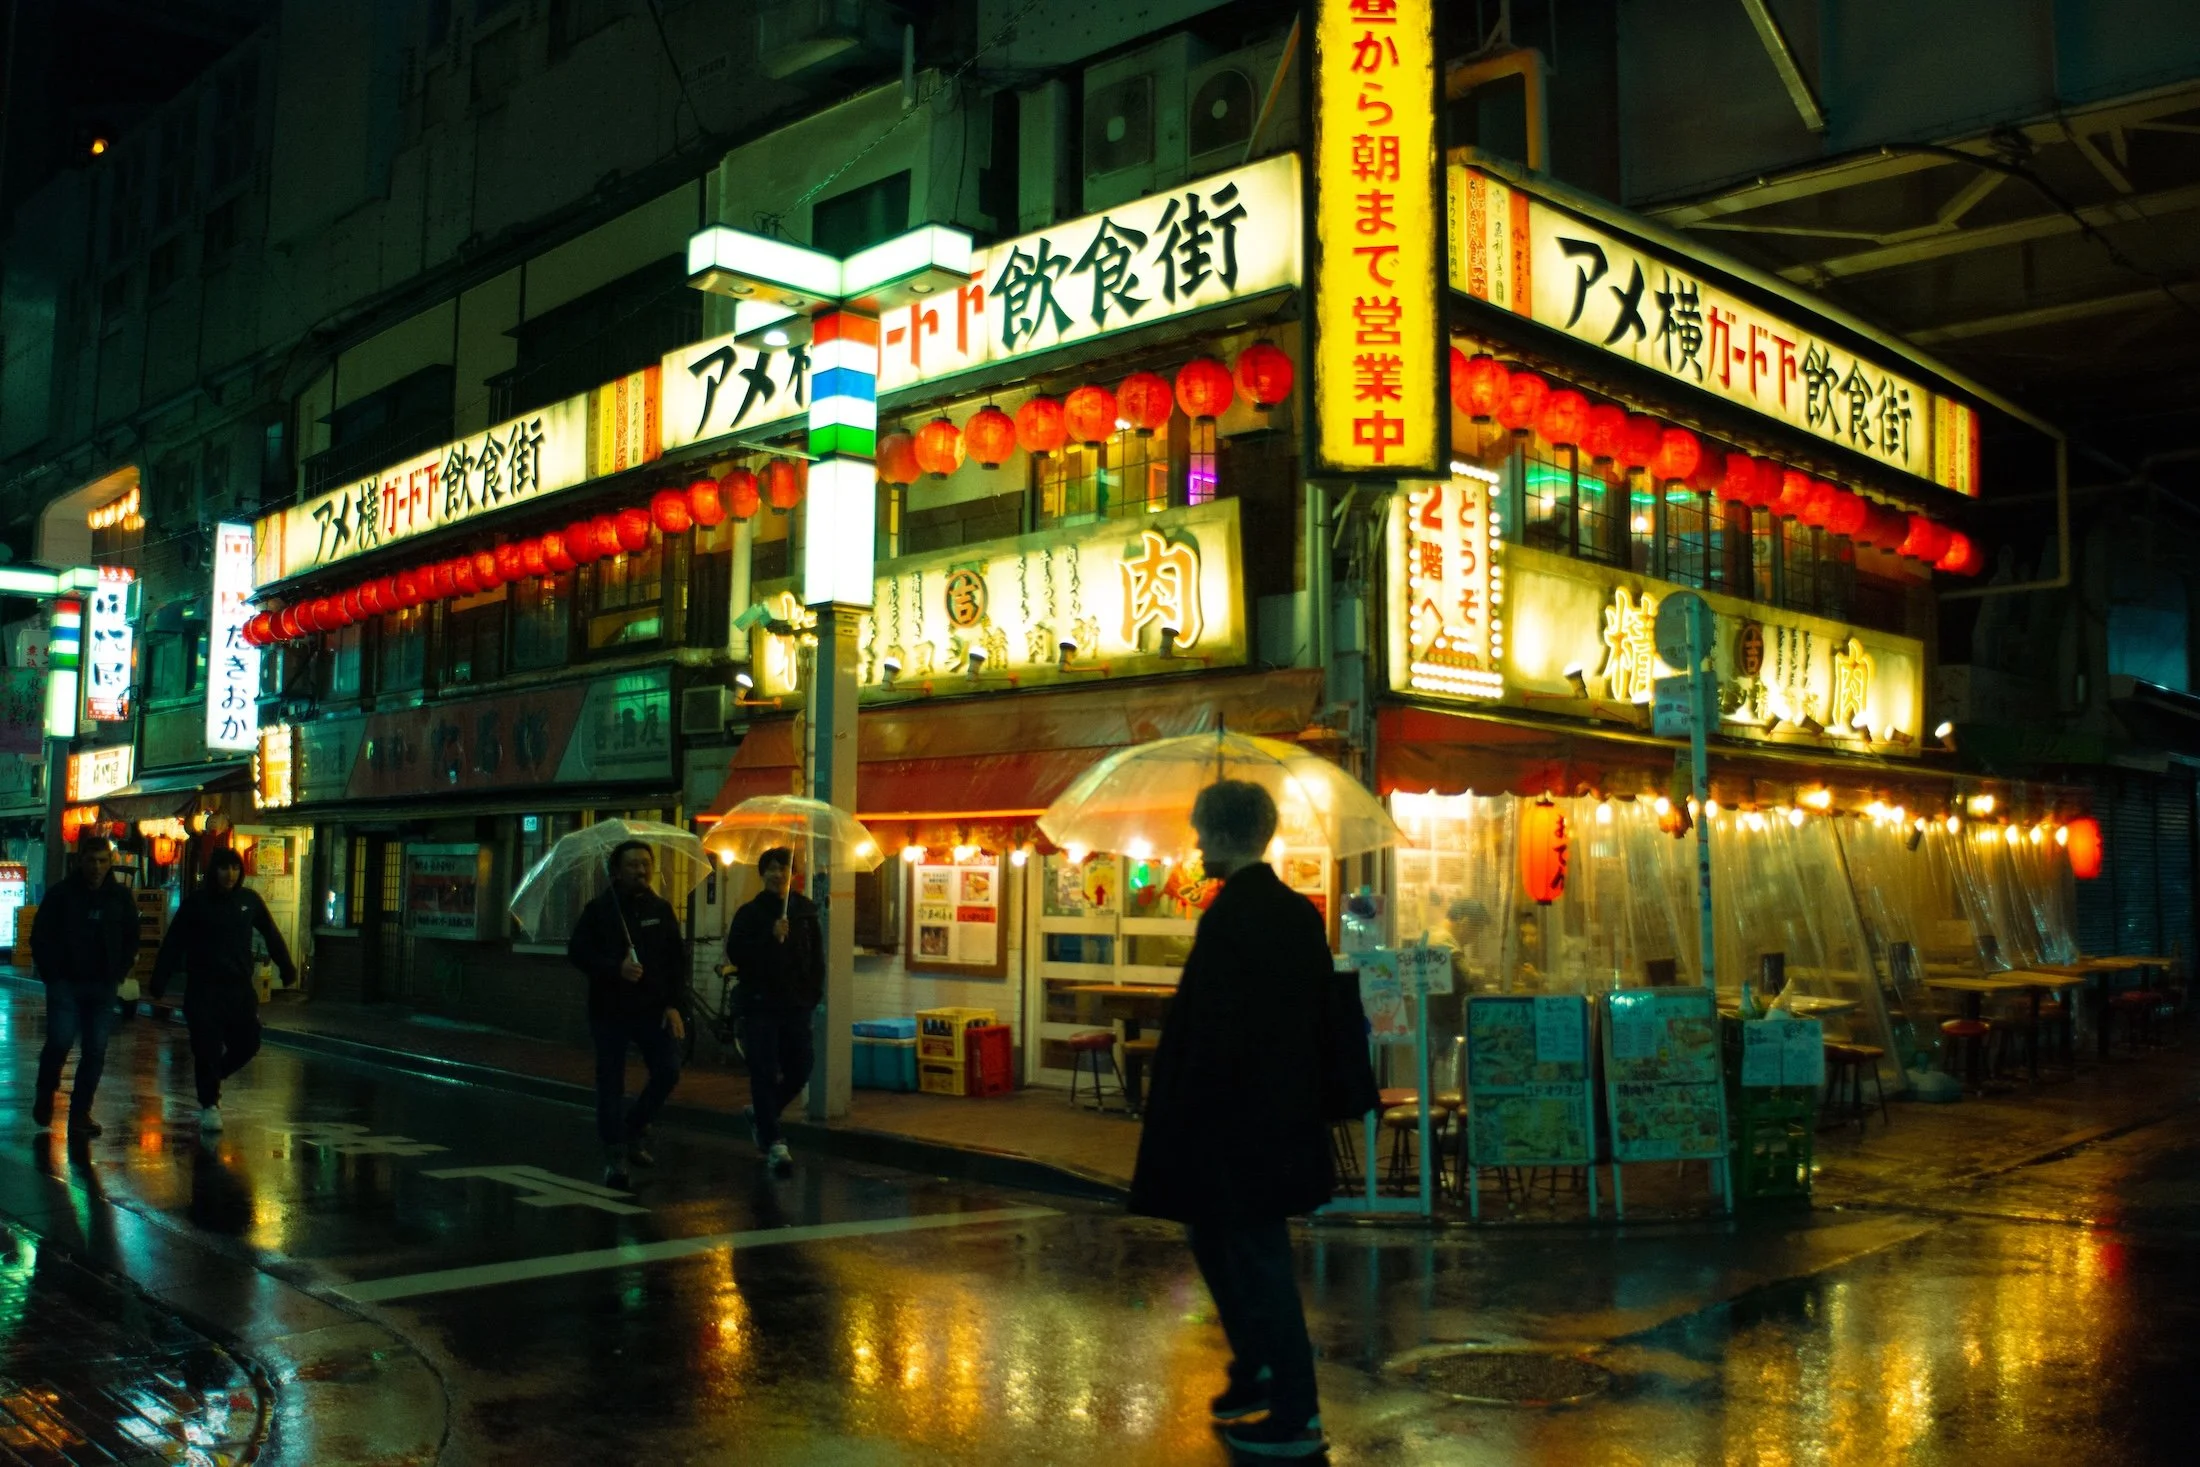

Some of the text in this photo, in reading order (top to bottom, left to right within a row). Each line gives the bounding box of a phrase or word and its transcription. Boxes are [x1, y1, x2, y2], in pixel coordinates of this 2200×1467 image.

[1350, 0, 1405, 464] 昼から朝まで営業中
[688, 182, 1247, 438] アメード下飲食街
[1555, 236, 1911, 465] アメ横ガード下飲食街
[312, 416, 547, 564] アメ横ガード下飲食街
[1458, 489, 1480, 625] どうぞ
[1119, 530, 1203, 650] 肉
[1832, 638, 1876, 728] 肉
